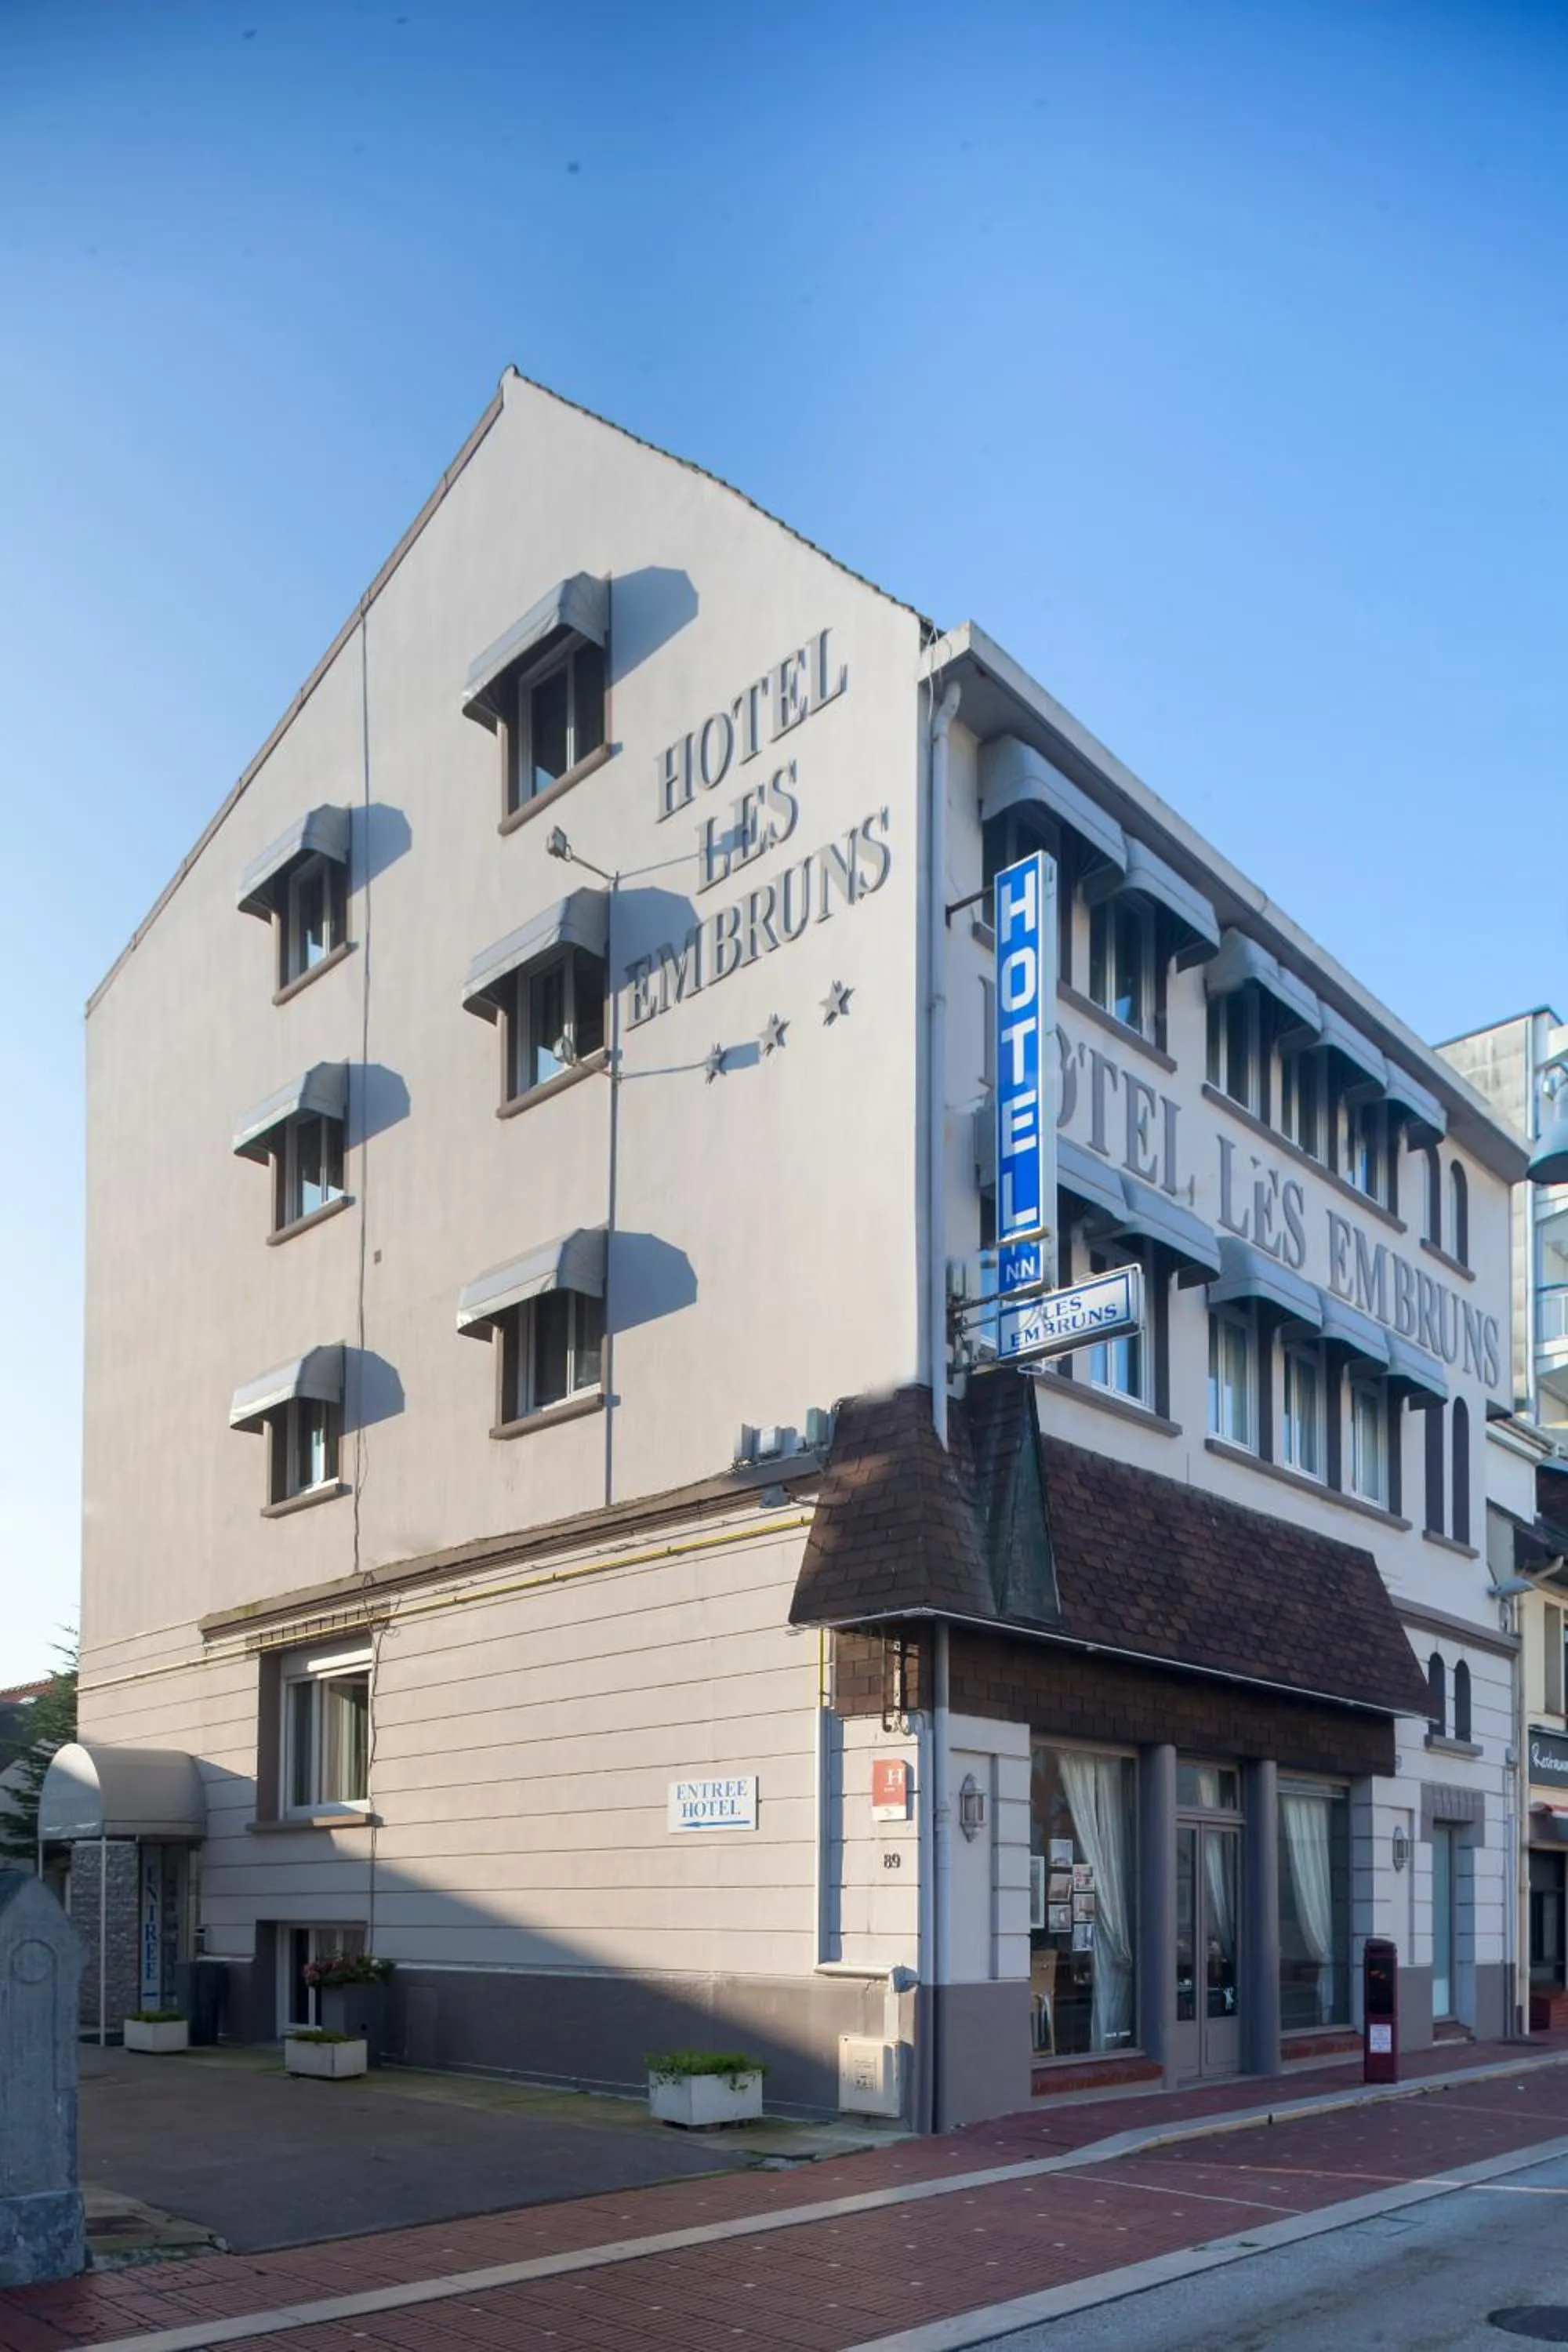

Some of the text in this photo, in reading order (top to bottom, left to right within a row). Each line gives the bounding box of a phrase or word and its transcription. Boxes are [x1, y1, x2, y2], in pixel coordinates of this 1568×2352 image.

[656, 627, 848, 823] HOTEL
[695, 759, 799, 895] LES
[624, 806, 891, 1032] EMBRUNS
[1000, 867, 1037, 1230] HOTEL
[1006, 1256, 1036, 1284] NN
[1216, 1133, 1307, 1270] LES
[1326, 1208, 1500, 1390] EMBRUNS
[1011, 1304, 1117, 1347] EMBRUNS
[1044, 1296, 1082, 1319] LES
[677, 1780, 748, 1800] ENTREE
[887, 1768, 903, 1785] H
[681, 1799, 741, 1817] HOTEL
[884, 1853, 901, 1868] 89
[145, 1865, 158, 1980] ENTREE
